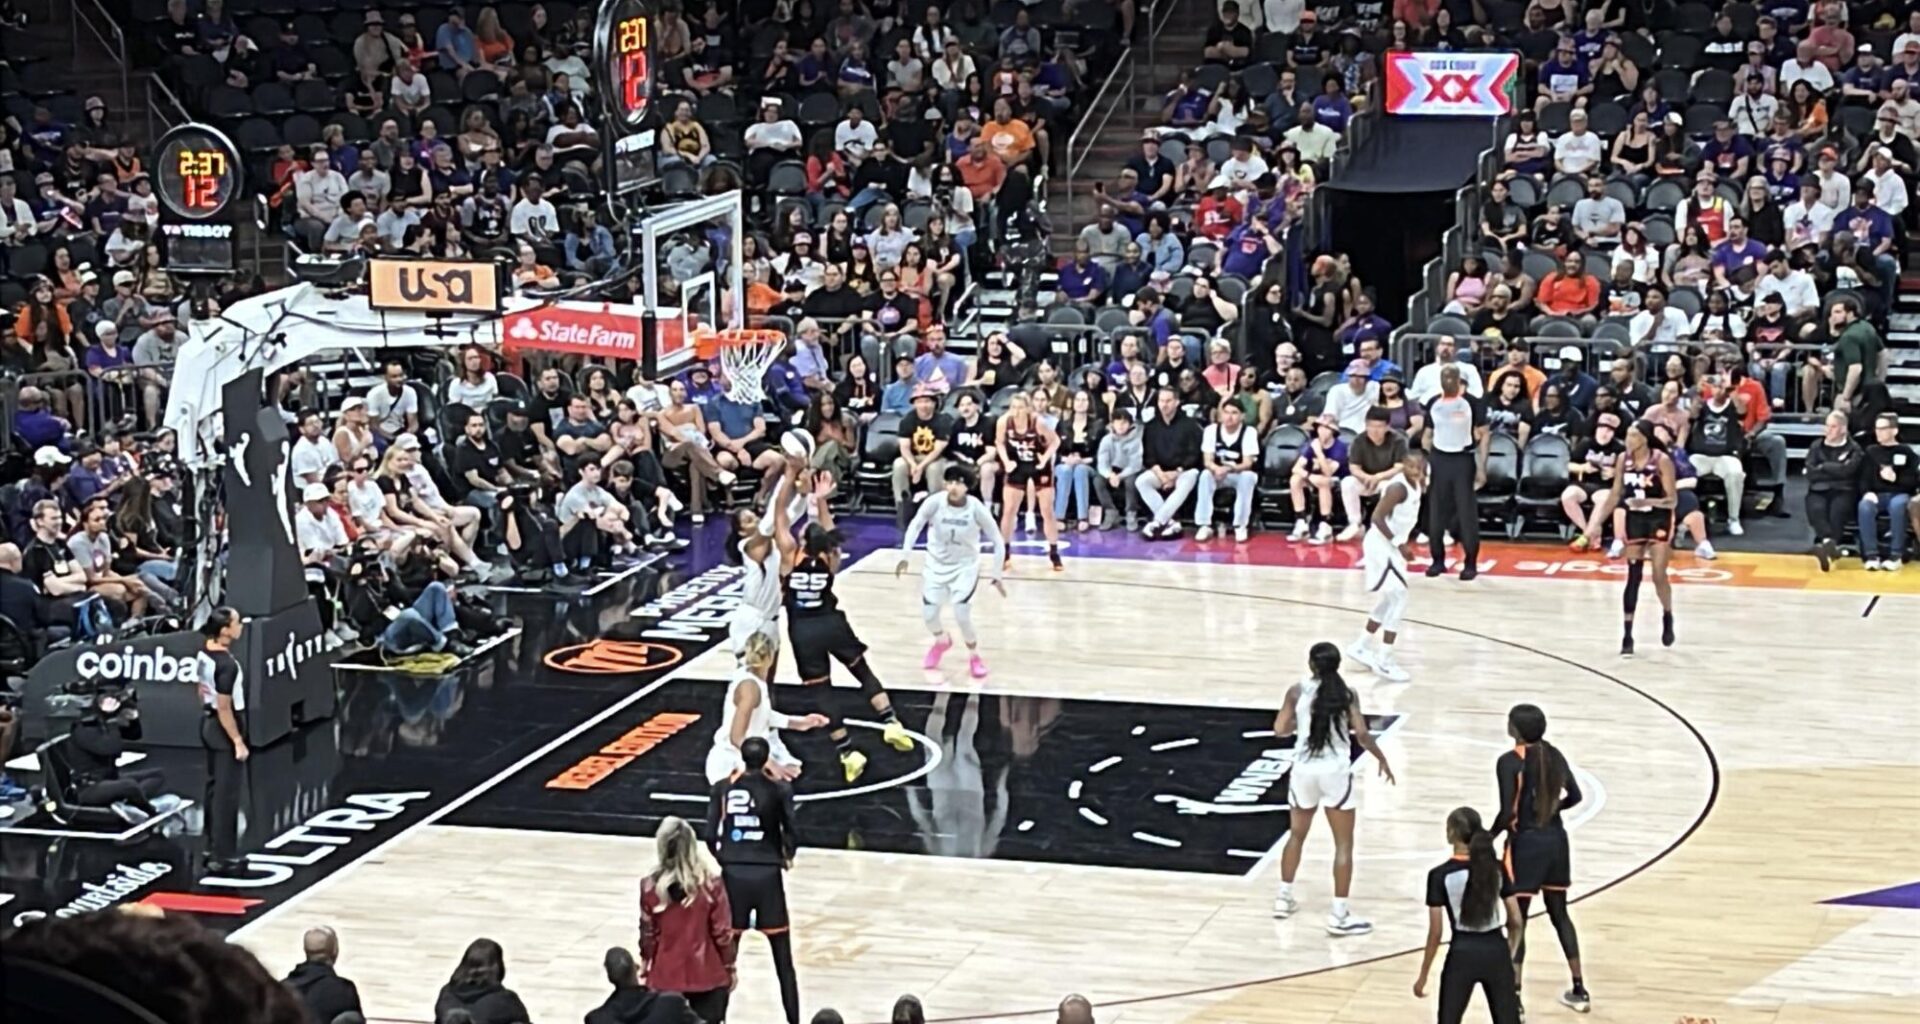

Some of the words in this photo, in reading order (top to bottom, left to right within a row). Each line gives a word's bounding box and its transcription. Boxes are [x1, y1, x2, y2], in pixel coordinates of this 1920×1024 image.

[626, 51, 647, 110] 12
[1422, 74, 1485, 104] XX
[180, 151, 225, 176] 2:37
[187, 175, 218, 207] 12
[789, 572, 829, 591] 25
[199, 791, 431, 888] ULTRA
